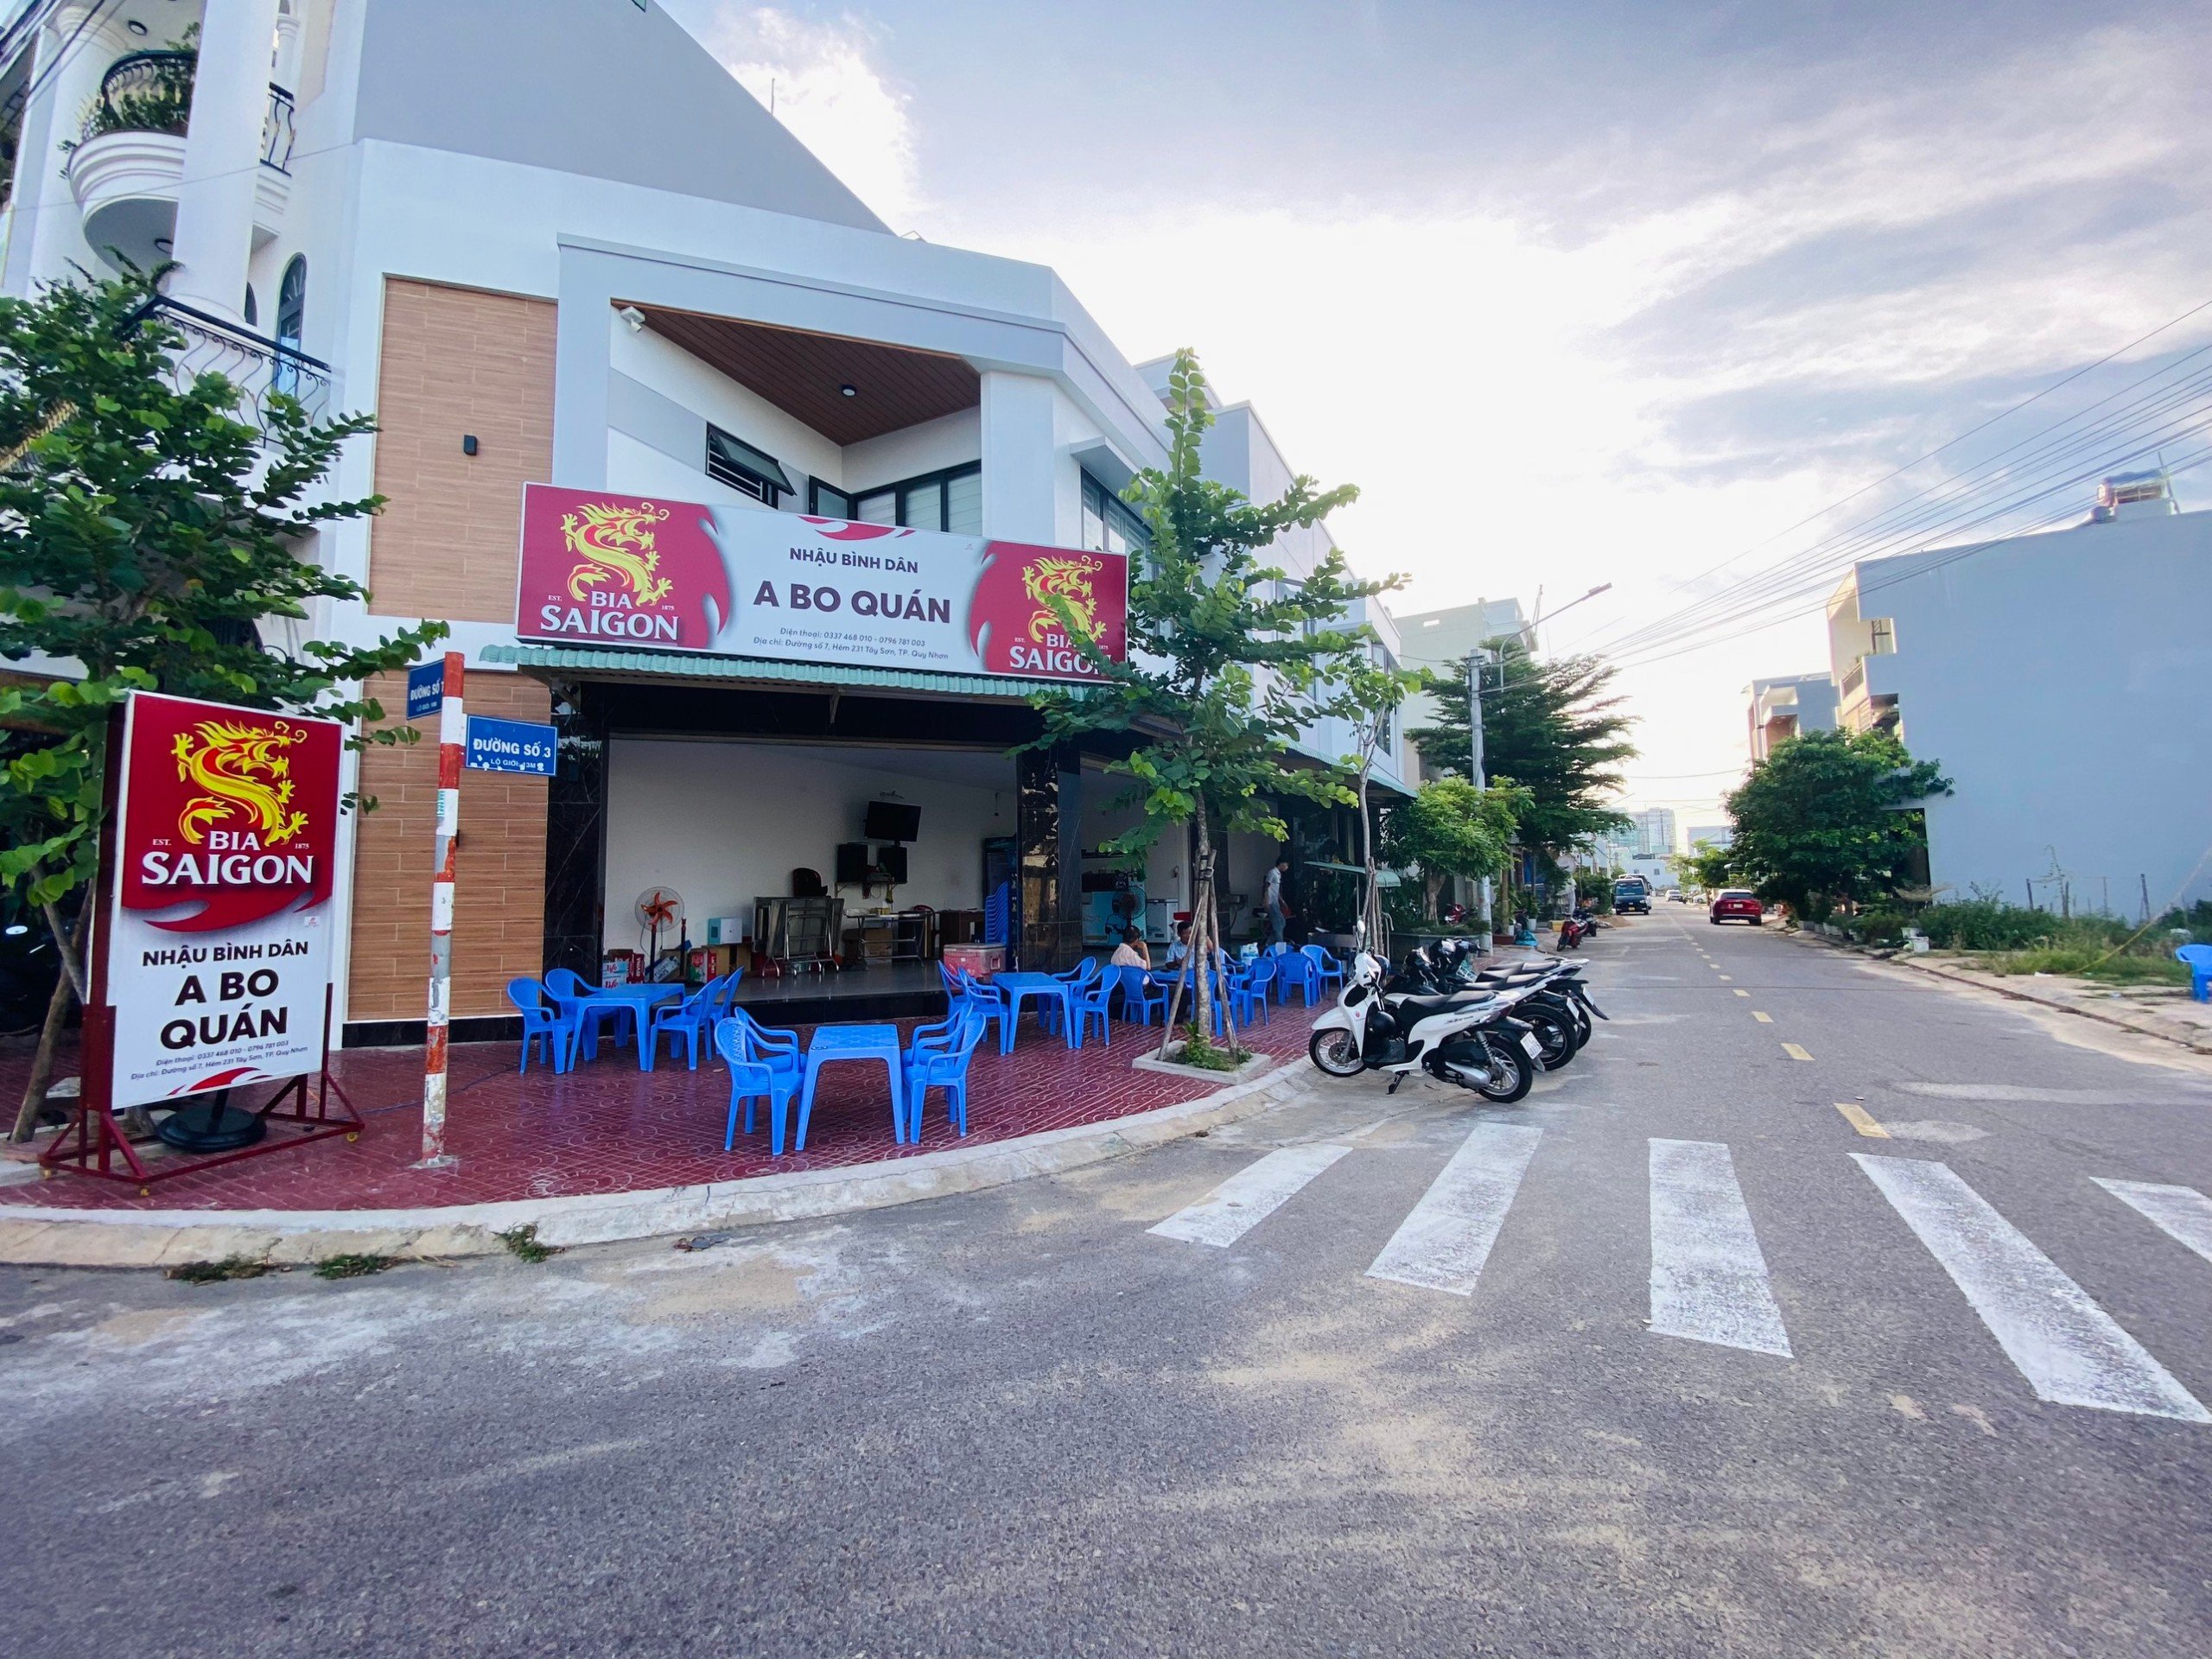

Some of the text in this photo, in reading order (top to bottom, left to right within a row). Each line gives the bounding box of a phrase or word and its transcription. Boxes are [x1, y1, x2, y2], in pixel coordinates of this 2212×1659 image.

[790, 547, 918, 574] NHẬU BÌNH DÂN
[591, 590, 633, 610] BIA
[753, 580, 950, 624] A BO QUÁN
[540, 605, 680, 641] SAIGON
[753, 636, 767, 645] Địa
[785, 639, 812, 650] Đường
[866, 645, 879, 655] Tây
[880, 647, 896, 657] Sơn,
[912, 650, 927, 659] Quy
[780, 627, 798, 638] Điện
[823, 631, 842, 640] 0337
[843, 632, 858, 641] 468
[879, 636, 897, 645] 0796
[912, 639, 925, 647] 003
[473, 737, 551, 759] ĐƯỜNG SỐ 3
[152, 838, 171, 847] EST.
[208, 830, 260, 851] BIA
[295, 842, 309, 850] 1875
[142, 851, 314, 886] SAIGON
[143, 938, 308, 969] NHẬU BÌNH DÂN
[175, 969, 279, 1006] A BO
[160, 1002, 288, 1050] QUÁN
